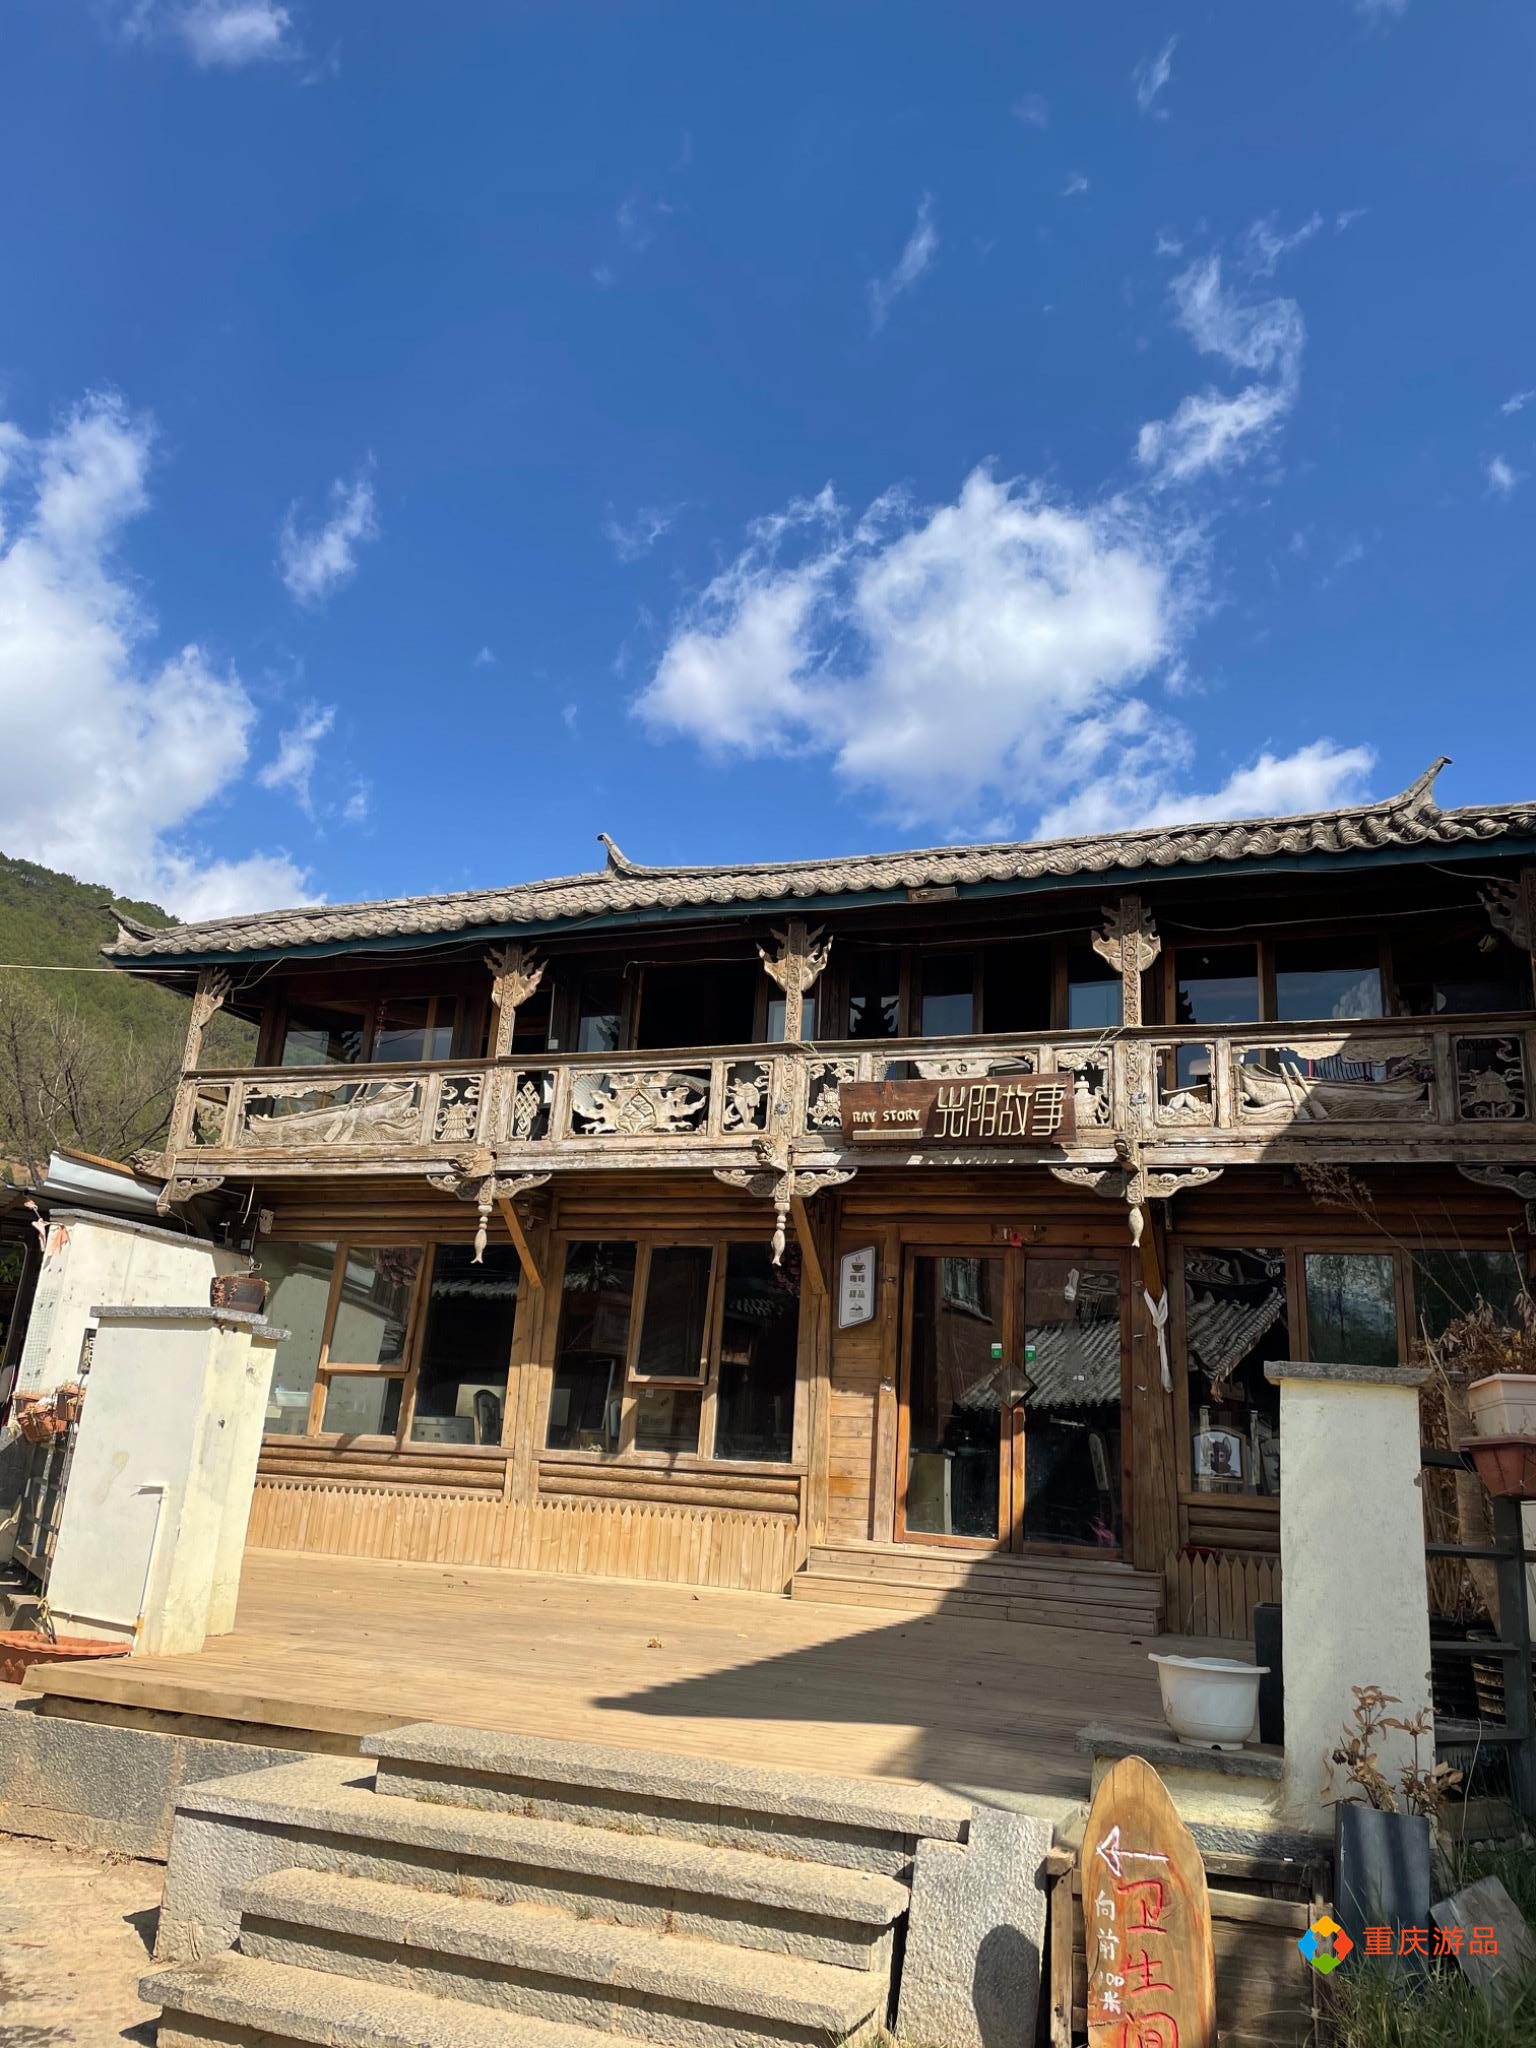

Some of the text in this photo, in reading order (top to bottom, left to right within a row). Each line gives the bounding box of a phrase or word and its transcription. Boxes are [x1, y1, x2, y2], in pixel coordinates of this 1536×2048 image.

[852, 1108, 921, 1123] RAY STORY
[934, 1083, 1067, 1138] 光阴故事
